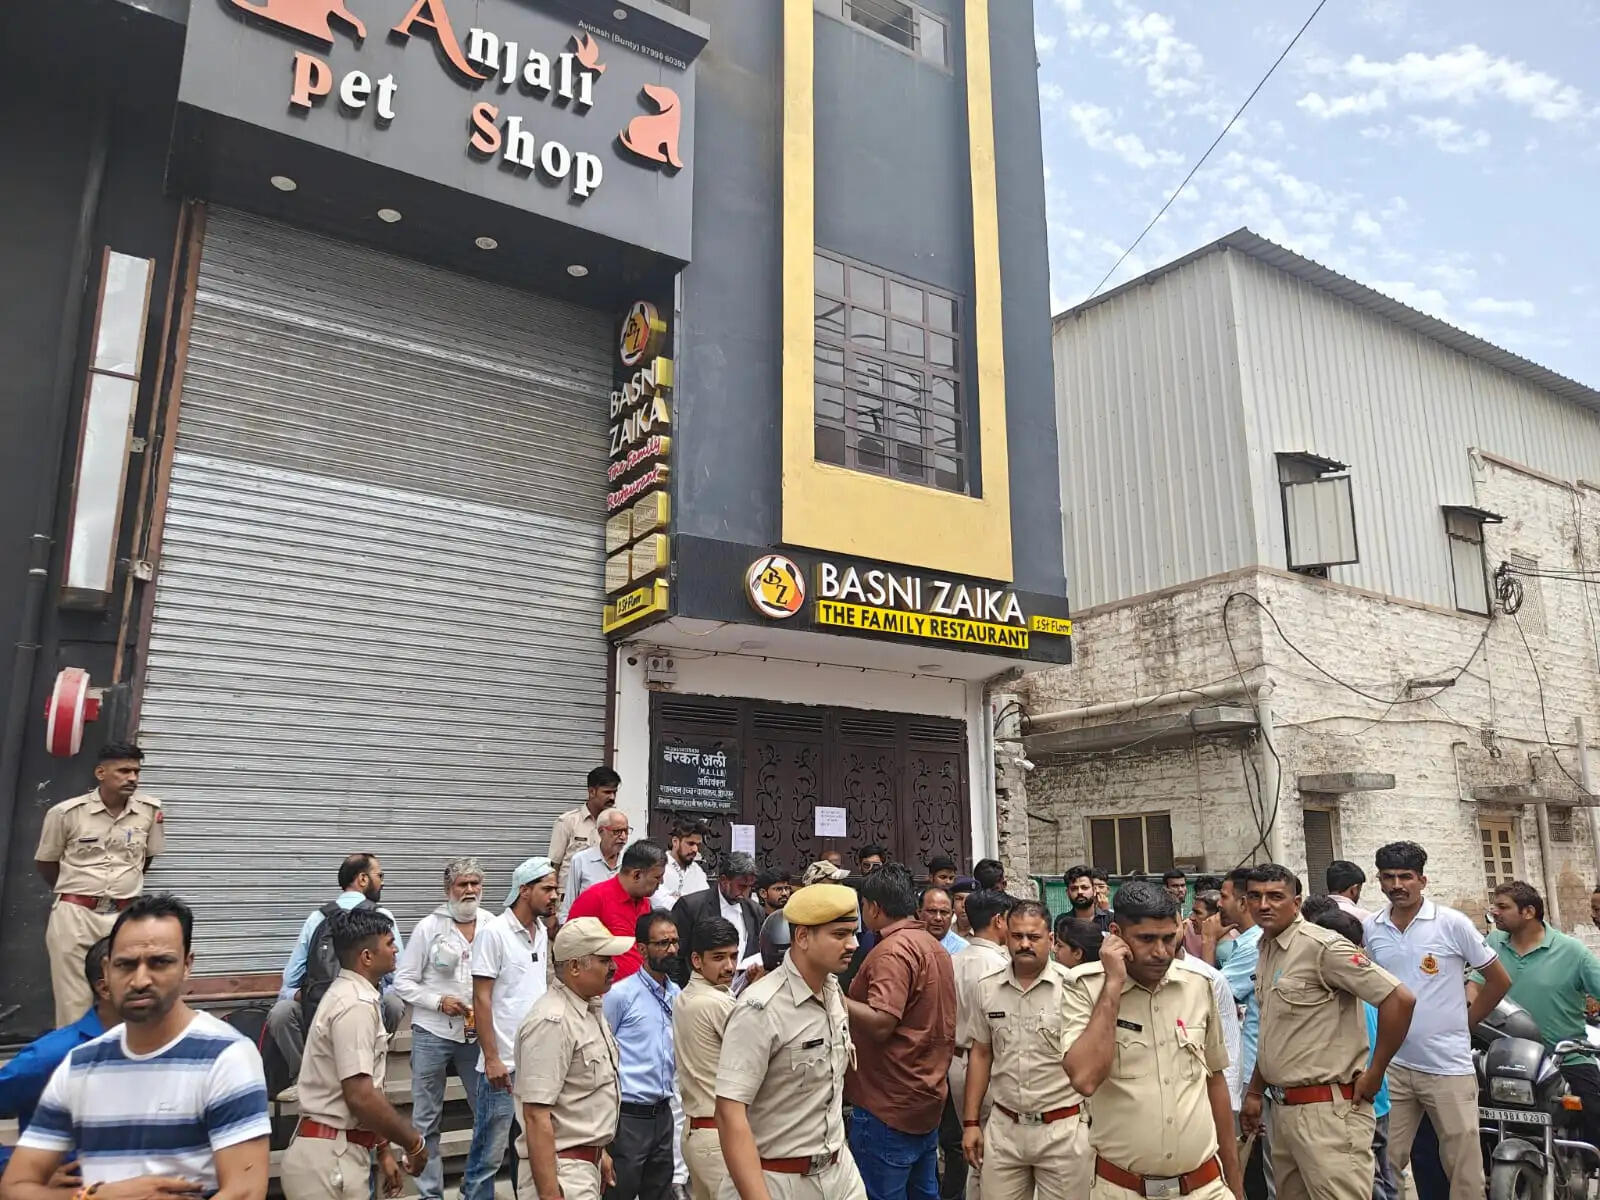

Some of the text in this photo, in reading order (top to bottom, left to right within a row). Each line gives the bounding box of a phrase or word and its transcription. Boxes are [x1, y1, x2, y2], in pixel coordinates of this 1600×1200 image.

[391, 0, 595, 106] Anjali
[578, 20, 610, 39] Avinash
[611, 32, 641, 52] (Bunty)
[471, 102, 603, 197] Shop
[609, 397, 663, 457] ZAIKA
[608, 460, 627, 482] The
[821, 562, 1026, 625] BASNI ZAIKA
[822, 603, 1028, 647] THE FAMILY RESTAURANT
[664, 751, 727, 768] बरकत अली
